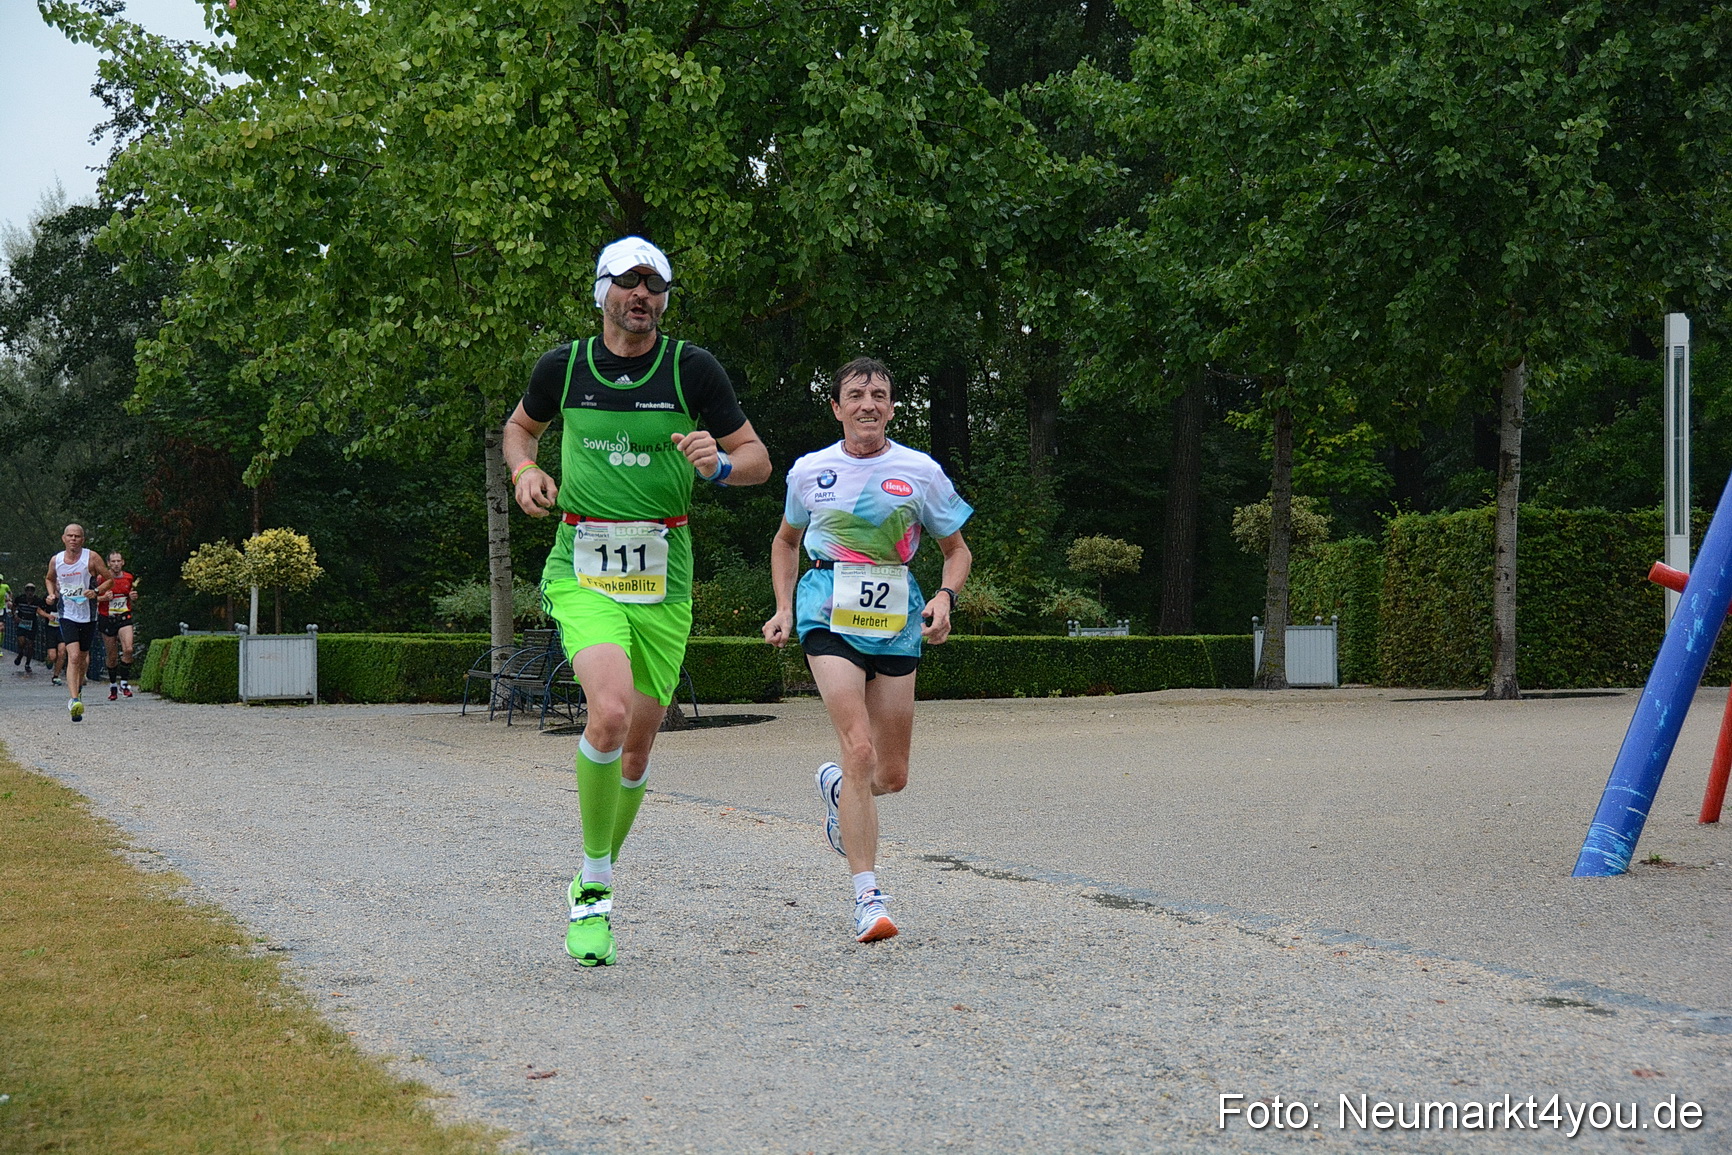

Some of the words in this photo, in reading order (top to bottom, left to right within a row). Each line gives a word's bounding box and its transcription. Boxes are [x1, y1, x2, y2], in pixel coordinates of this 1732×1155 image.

[635, 401, 675, 409] FrankenBlitz
[583, 438, 623, 452] SoWiso
[630, 442, 652, 452] Run
[885, 482, 910, 493] Hervis
[814, 491, 837, 499] PARTL
[594, 544, 646, 573] 111
[871, 566, 902, 577] BOCK
[586, 576, 657, 593] FrankenBlitz
[859, 581, 890, 609] 52
[852, 614, 888, 628] Herbert
